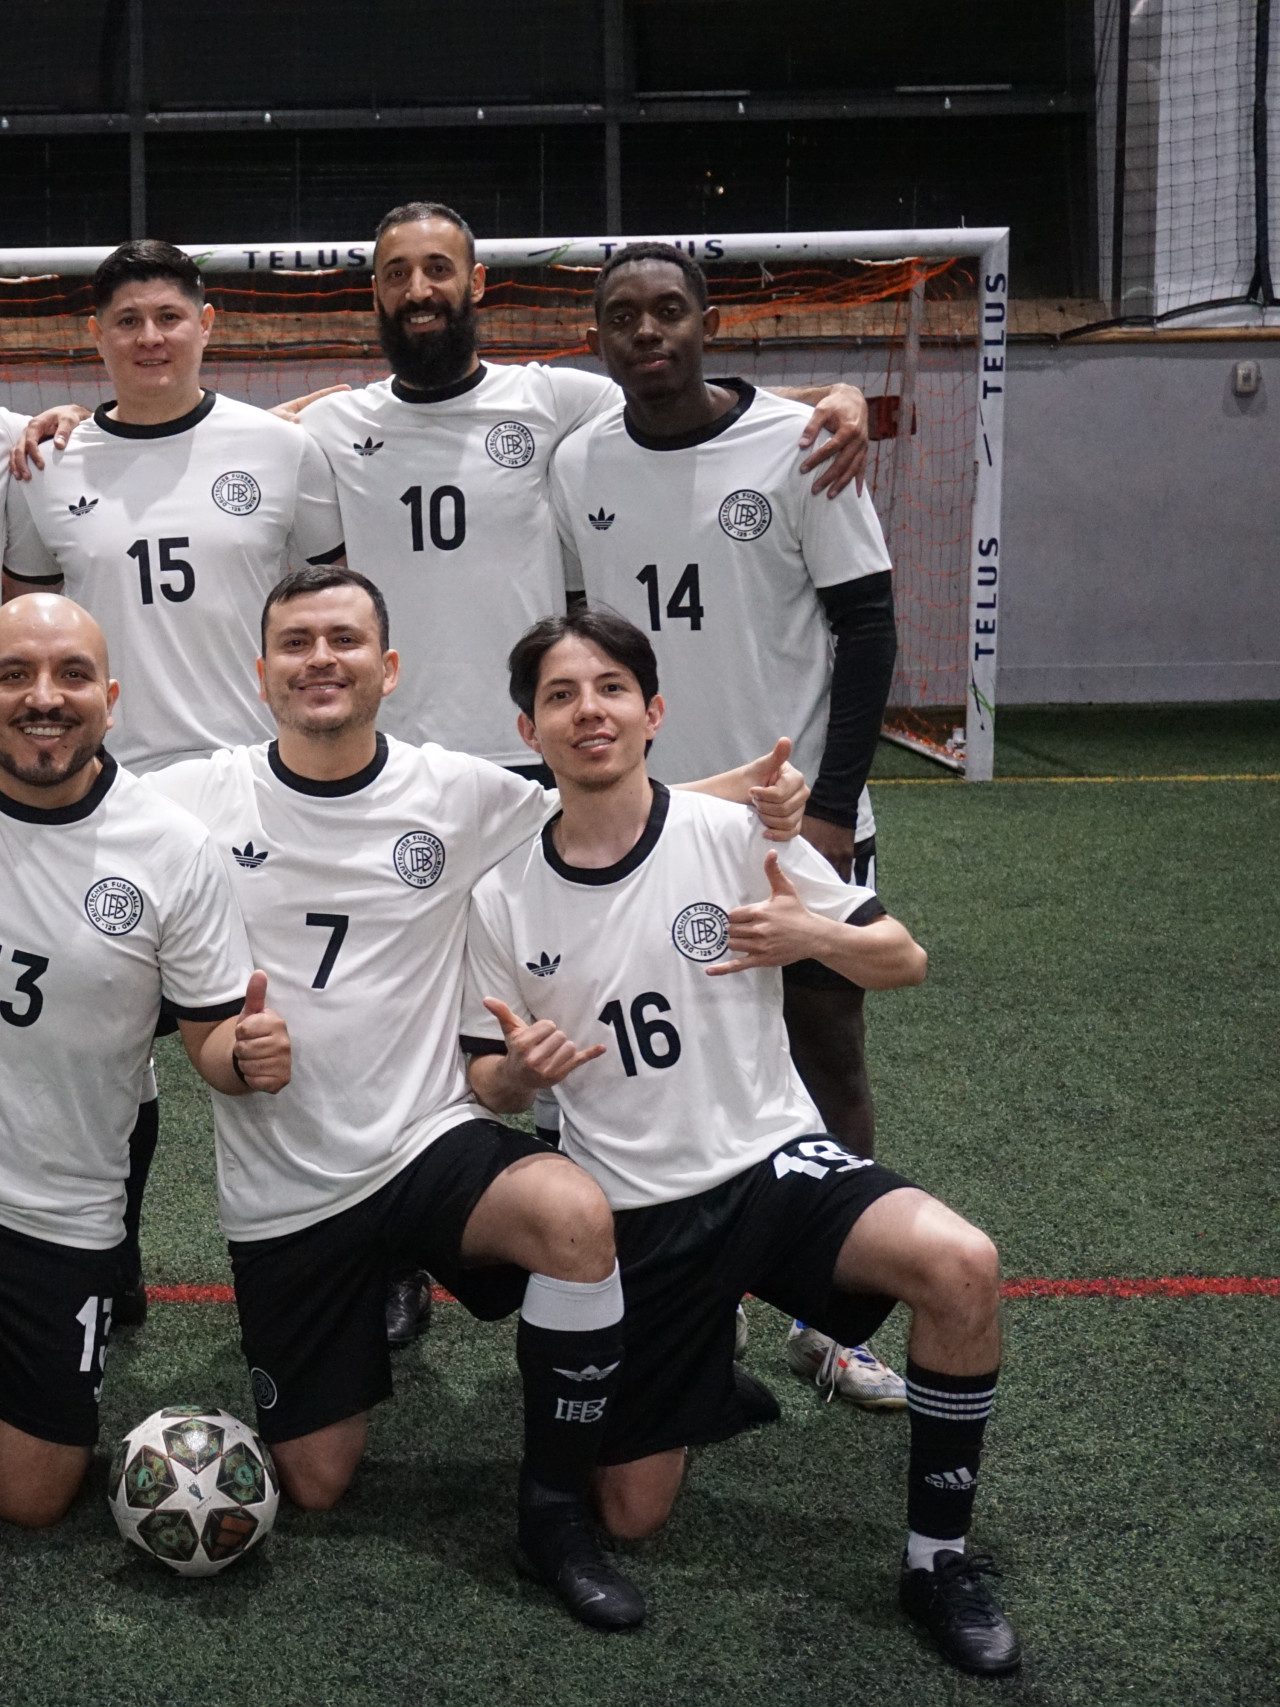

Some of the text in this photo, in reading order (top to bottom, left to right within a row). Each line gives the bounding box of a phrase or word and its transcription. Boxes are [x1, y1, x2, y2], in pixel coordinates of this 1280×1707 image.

[243, 248, 367, 269] TELUS
[983, 273, 1006, 399] TELUS
[400, 485, 465, 551] 10
[127, 537, 195, 605] 15
[636, 564, 704, 631] 14
[975, 537, 998, 660] TELUS
[306, 913, 349, 989] 7
[598, 992, 681, 1077] 16
